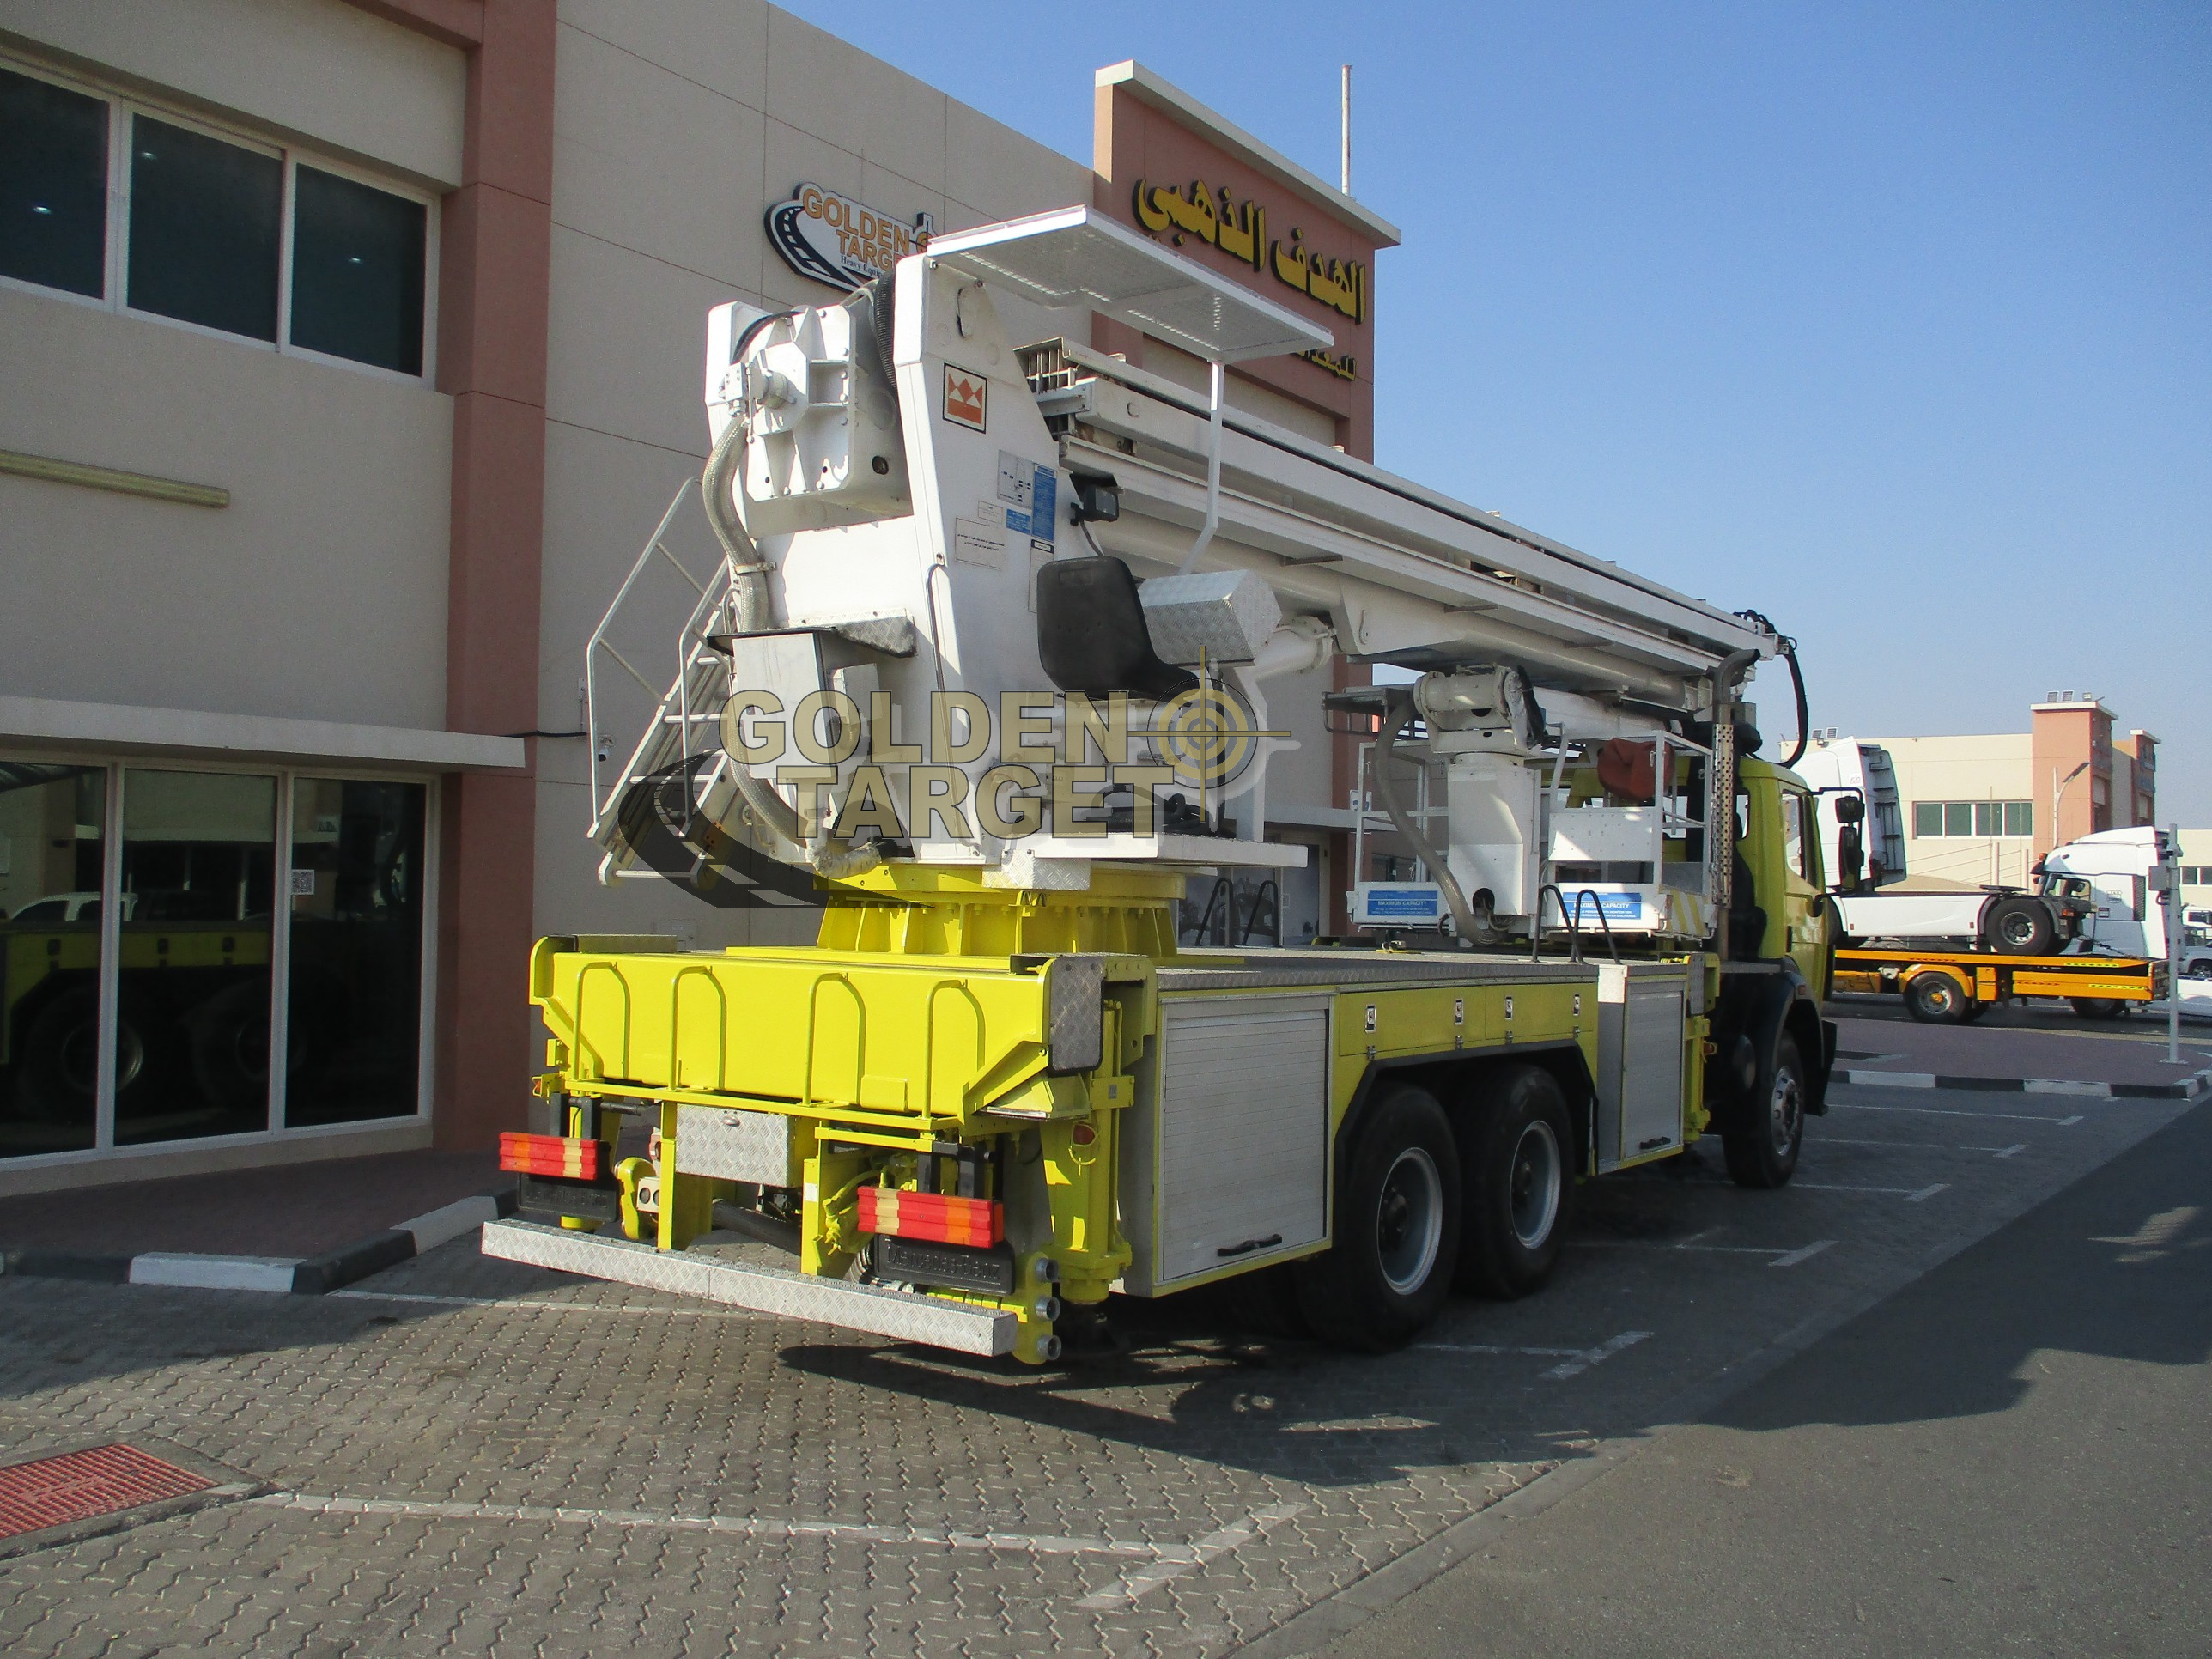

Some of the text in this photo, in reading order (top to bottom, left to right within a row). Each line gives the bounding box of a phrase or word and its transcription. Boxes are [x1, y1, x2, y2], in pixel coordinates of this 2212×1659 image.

[803, 187, 910, 257] GOLDEN
[836, 228, 902, 272] TARG
[842, 255, 862, 271] Heavy
[1133, 178, 1366, 325] الهدف الذهبي
